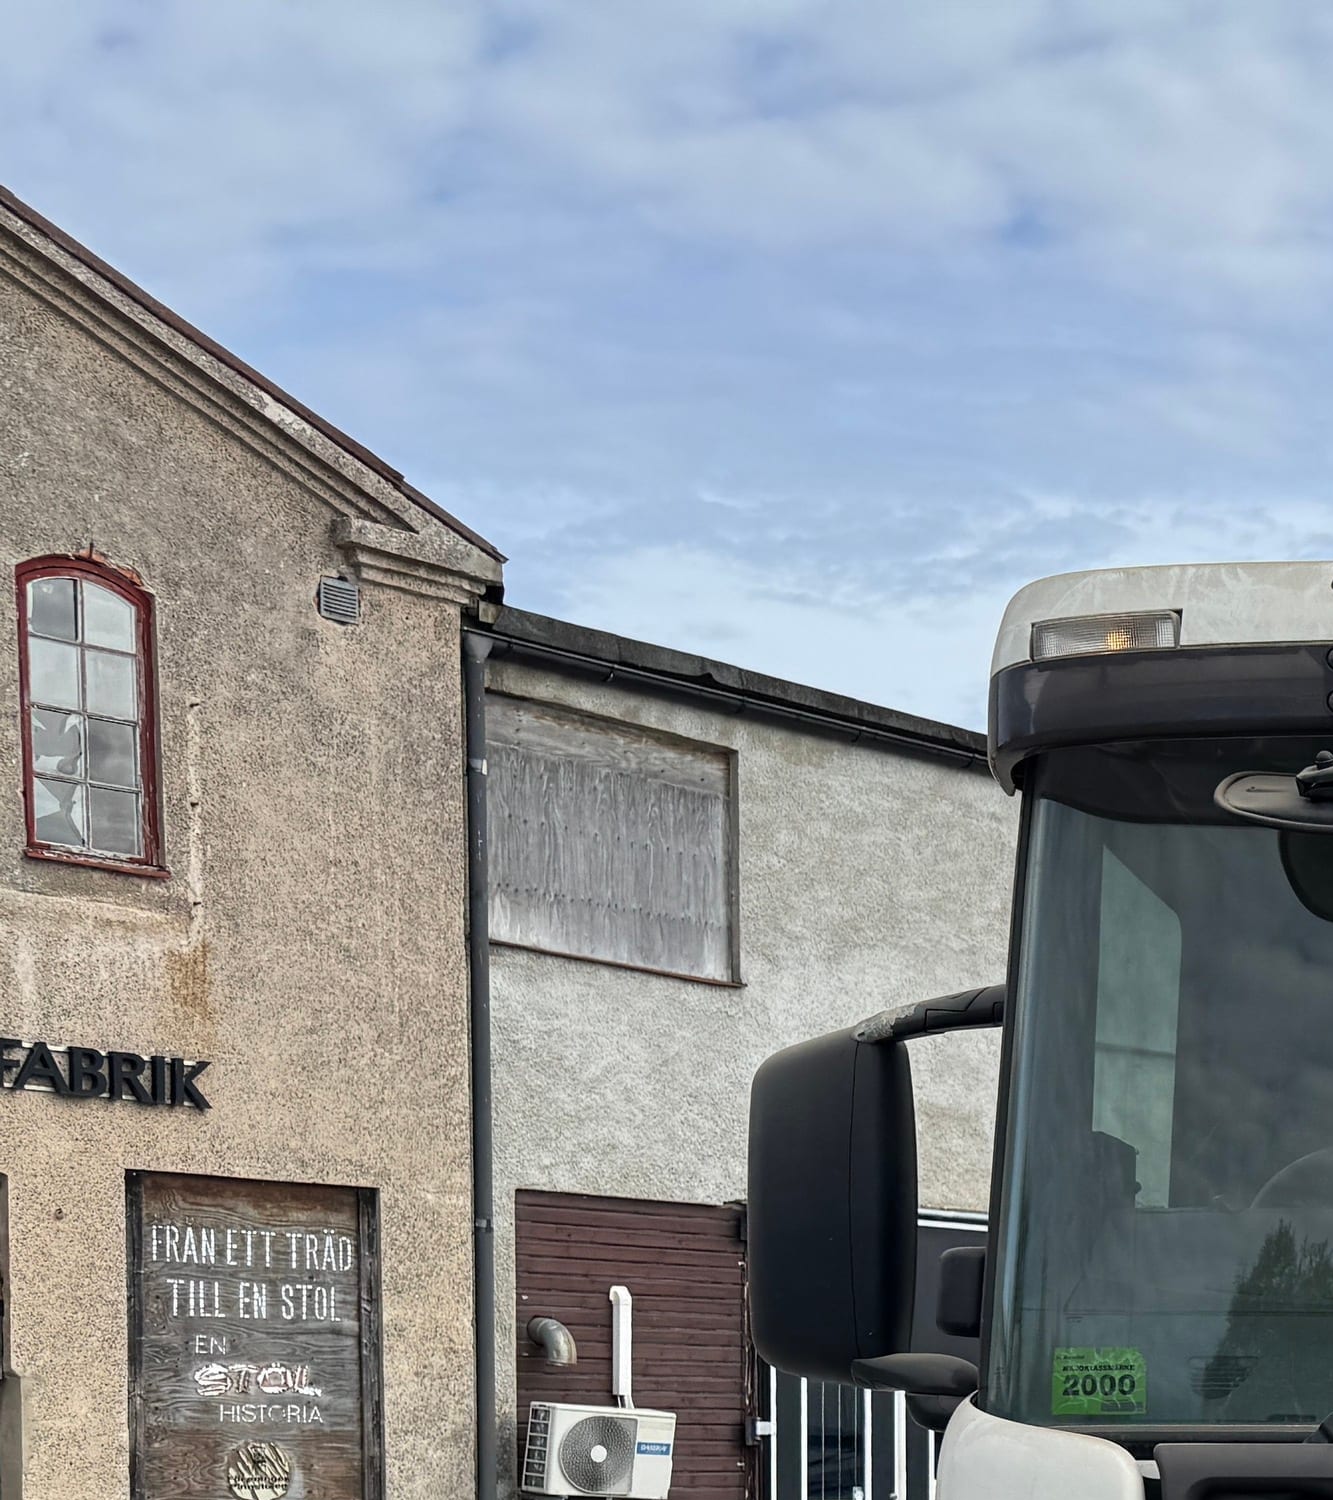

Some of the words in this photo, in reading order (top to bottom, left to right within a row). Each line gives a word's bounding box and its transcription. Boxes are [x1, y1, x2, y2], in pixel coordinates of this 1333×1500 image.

[0, 1037, 213, 1109] FABRIK
[226, 1228, 276, 1267] ETT
[285, 1228, 352, 1271] TRÄD
[166, 1278, 226, 1317] TILL
[239, 1281, 267, 1319] EN
[281, 1284, 341, 1322] STOL
[194, 1334, 226, 1355] EN
[219, 1404, 324, 1423] HISTORIA
